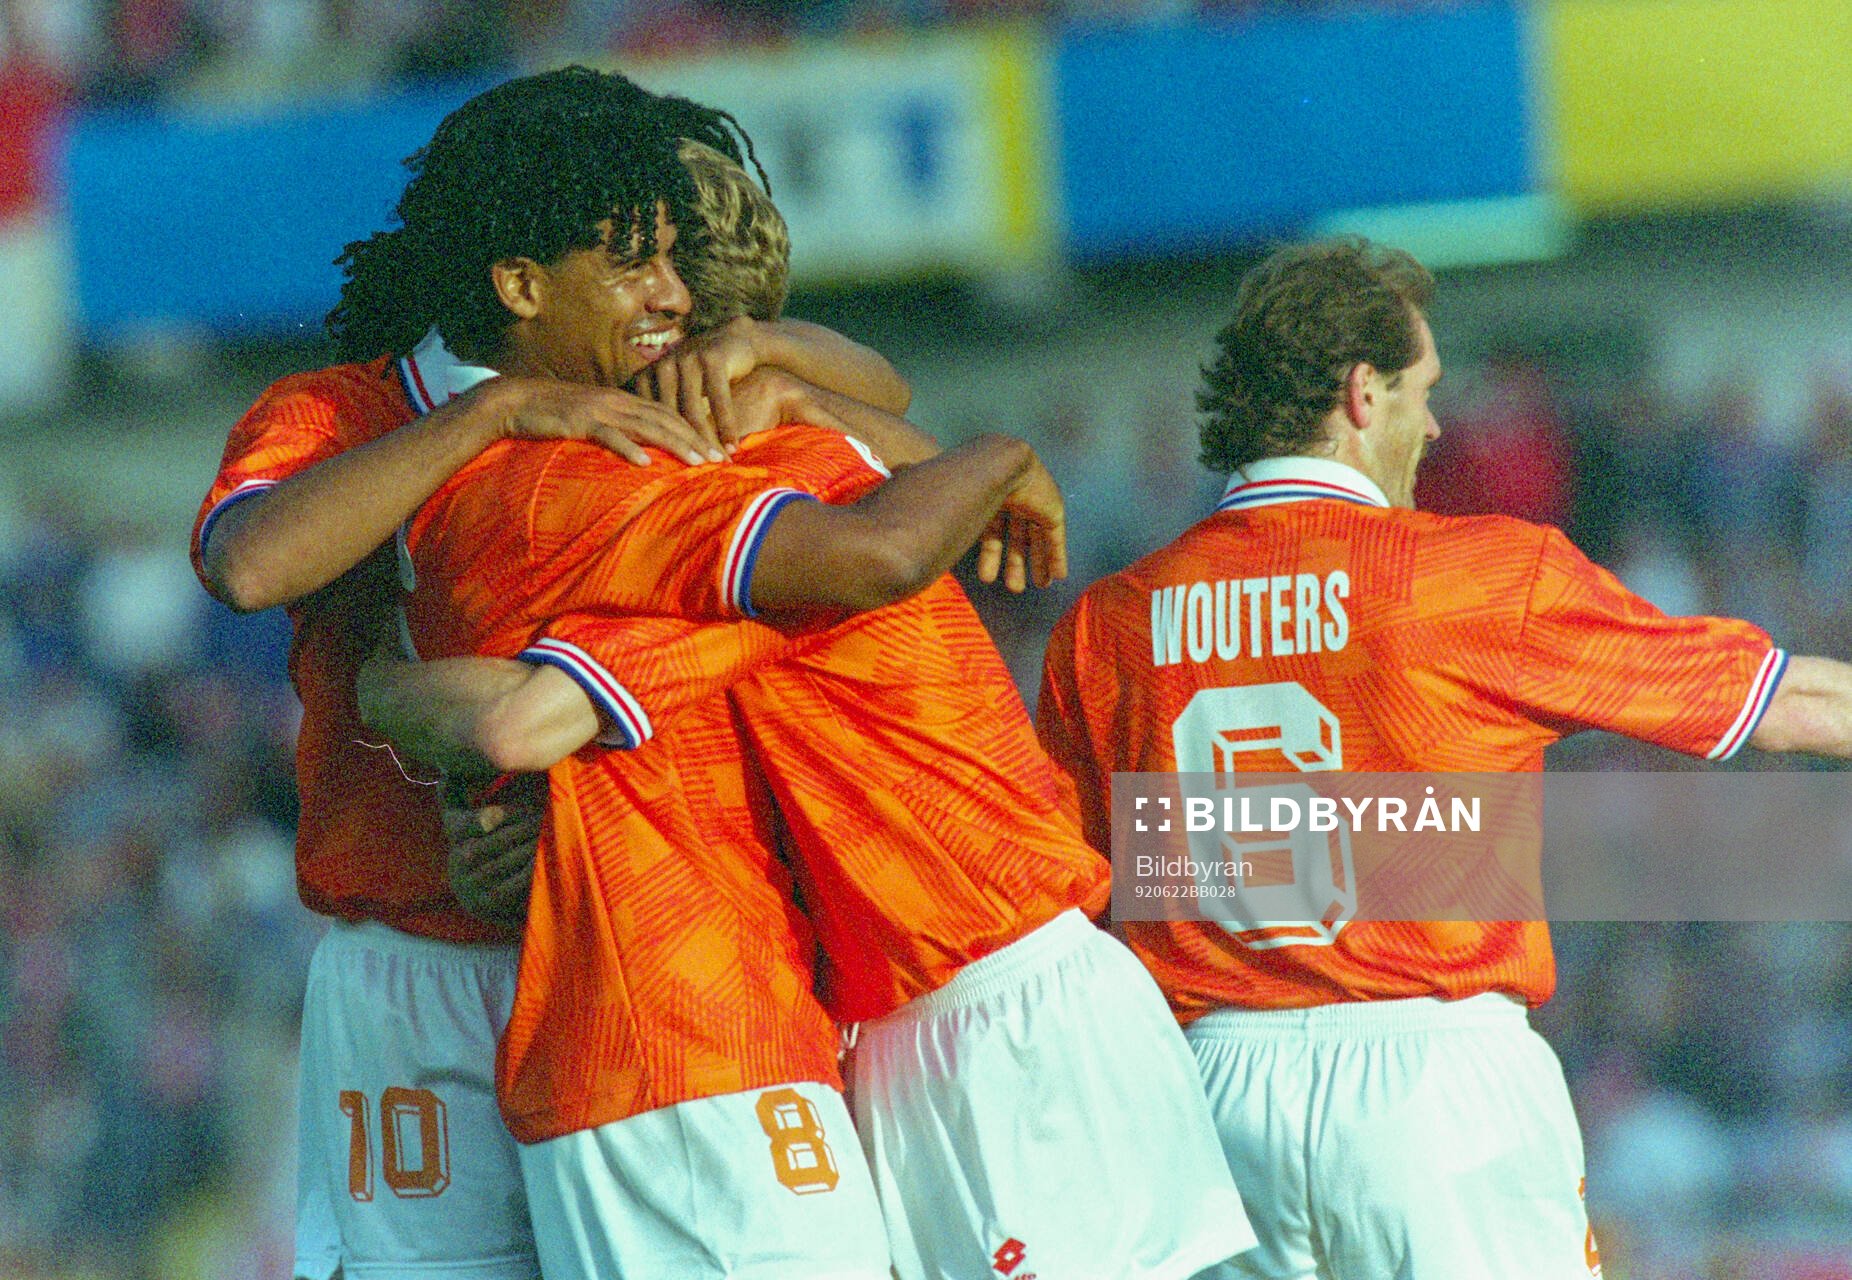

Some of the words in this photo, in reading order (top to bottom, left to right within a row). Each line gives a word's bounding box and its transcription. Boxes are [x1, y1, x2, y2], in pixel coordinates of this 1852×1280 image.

[1151, 570, 1350, 666] WOUTERS
[1172, 681, 1357, 948] 6
[339, 1086, 450, 1202] 10
[756, 1088, 840, 1195] 8
